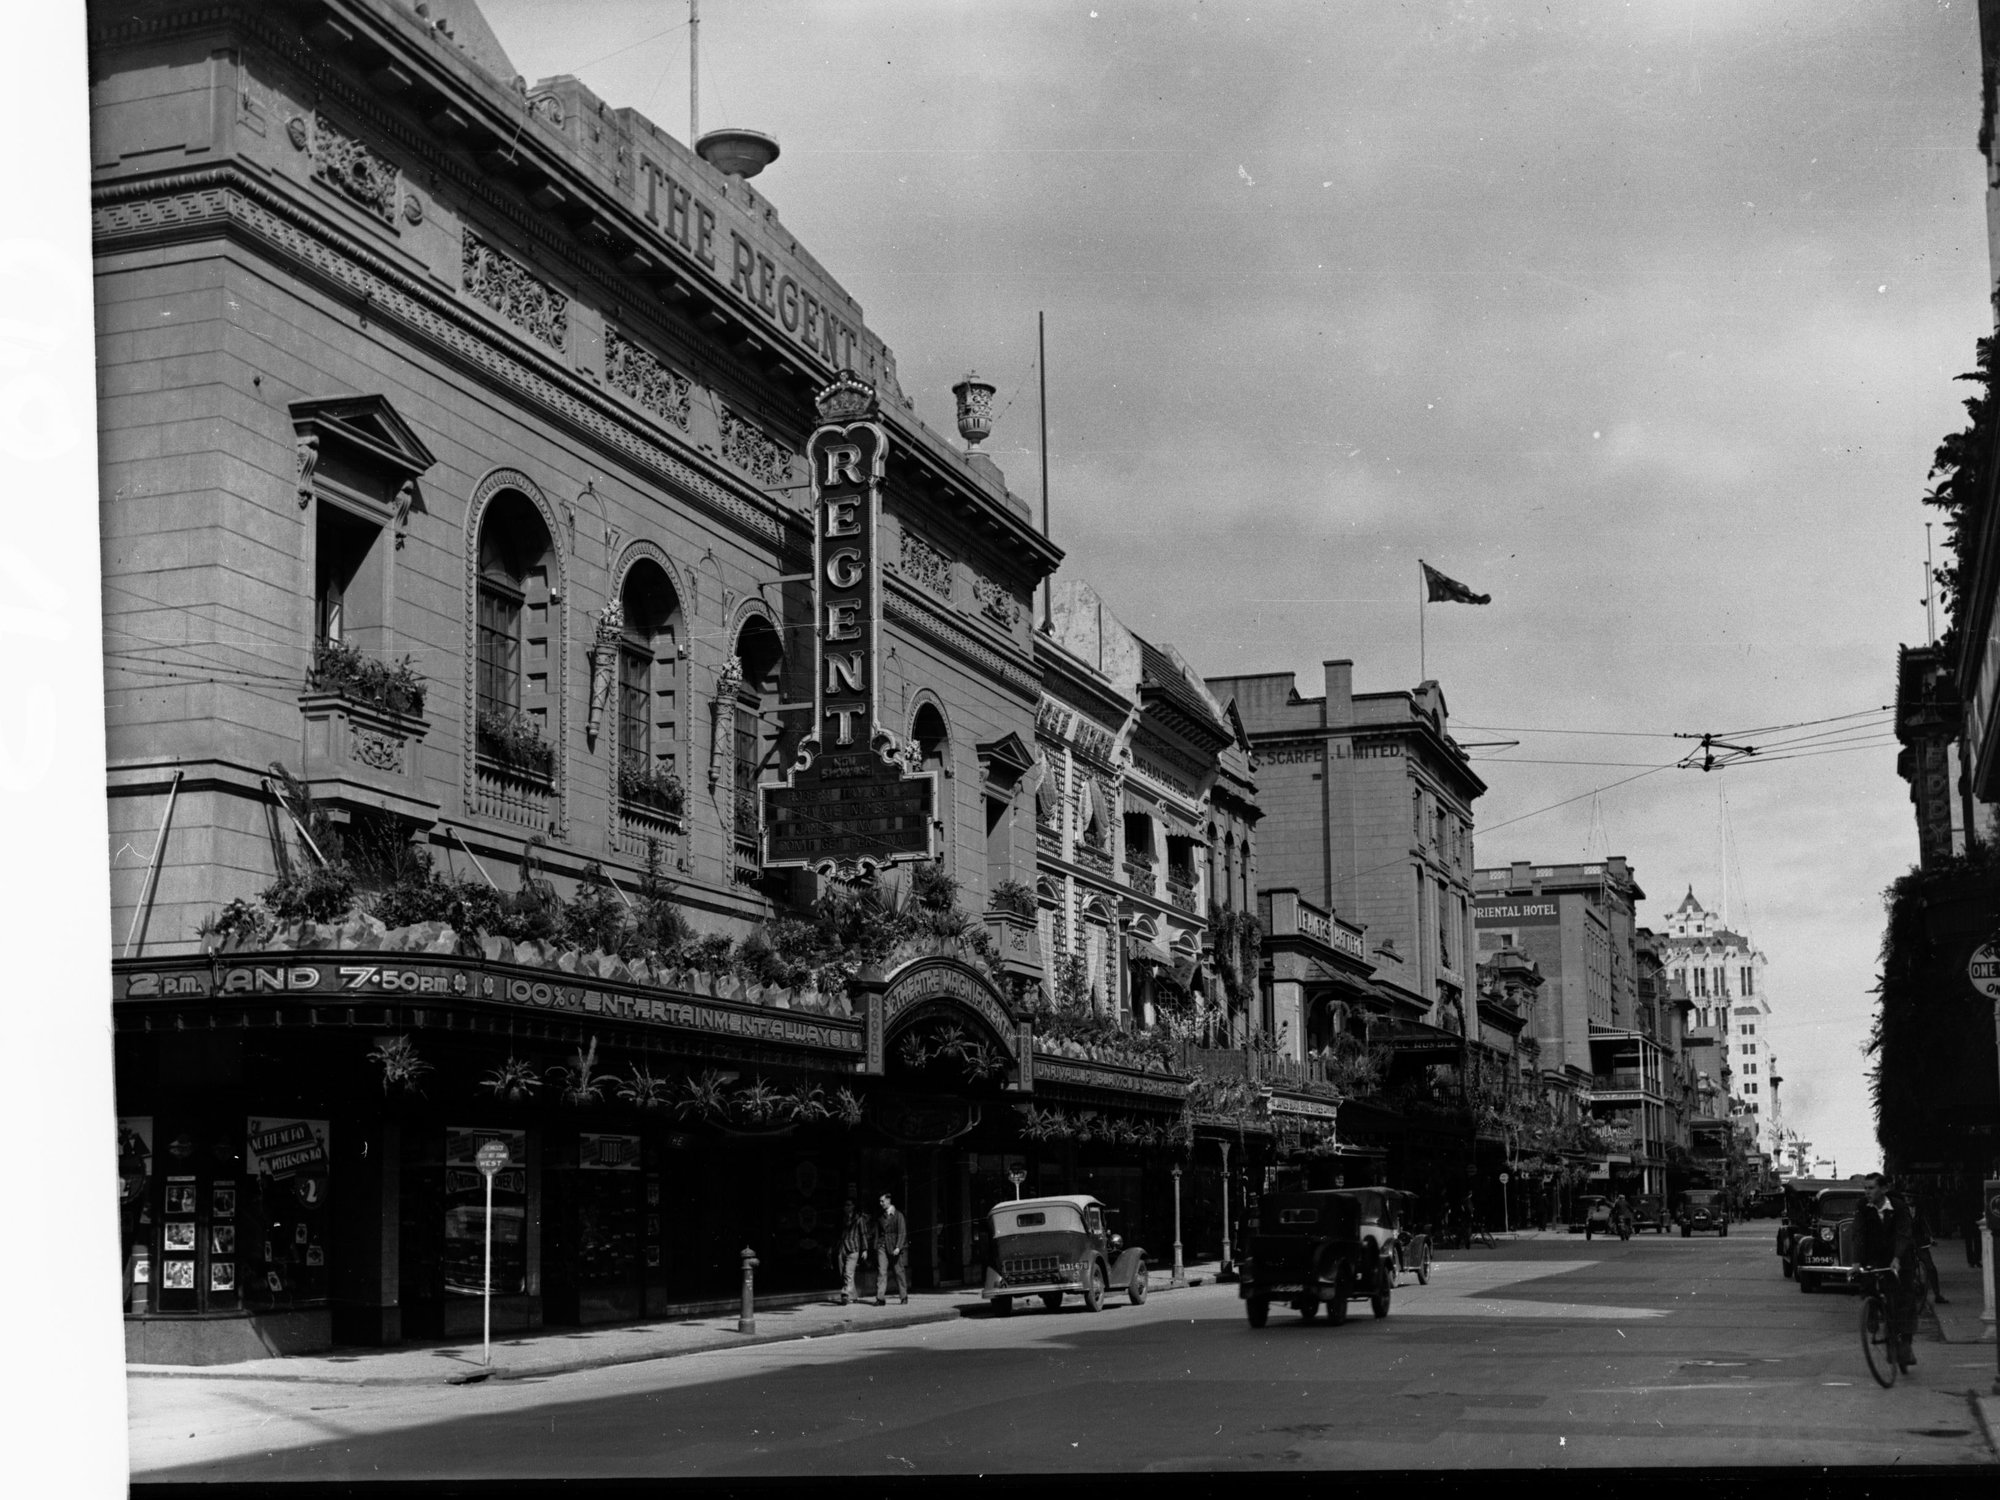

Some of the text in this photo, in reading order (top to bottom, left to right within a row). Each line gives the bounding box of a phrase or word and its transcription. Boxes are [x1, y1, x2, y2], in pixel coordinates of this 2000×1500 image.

[640, 153, 857, 370] THE REGENT
[824, 443, 866, 745] REGENT
[1523, 904, 1557, 916] HOTEL
[128, 972, 160, 997] 2
[224, 967, 320, 992] AND
[893, 968, 939, 1010] THEATRE
[943, 968, 1008, 1037] MAGNIFICENT
[1972, 963, 1996, 978] ONE
[506, 978, 842, 1048] 100% ENTERTAINMENT ALWAYS
